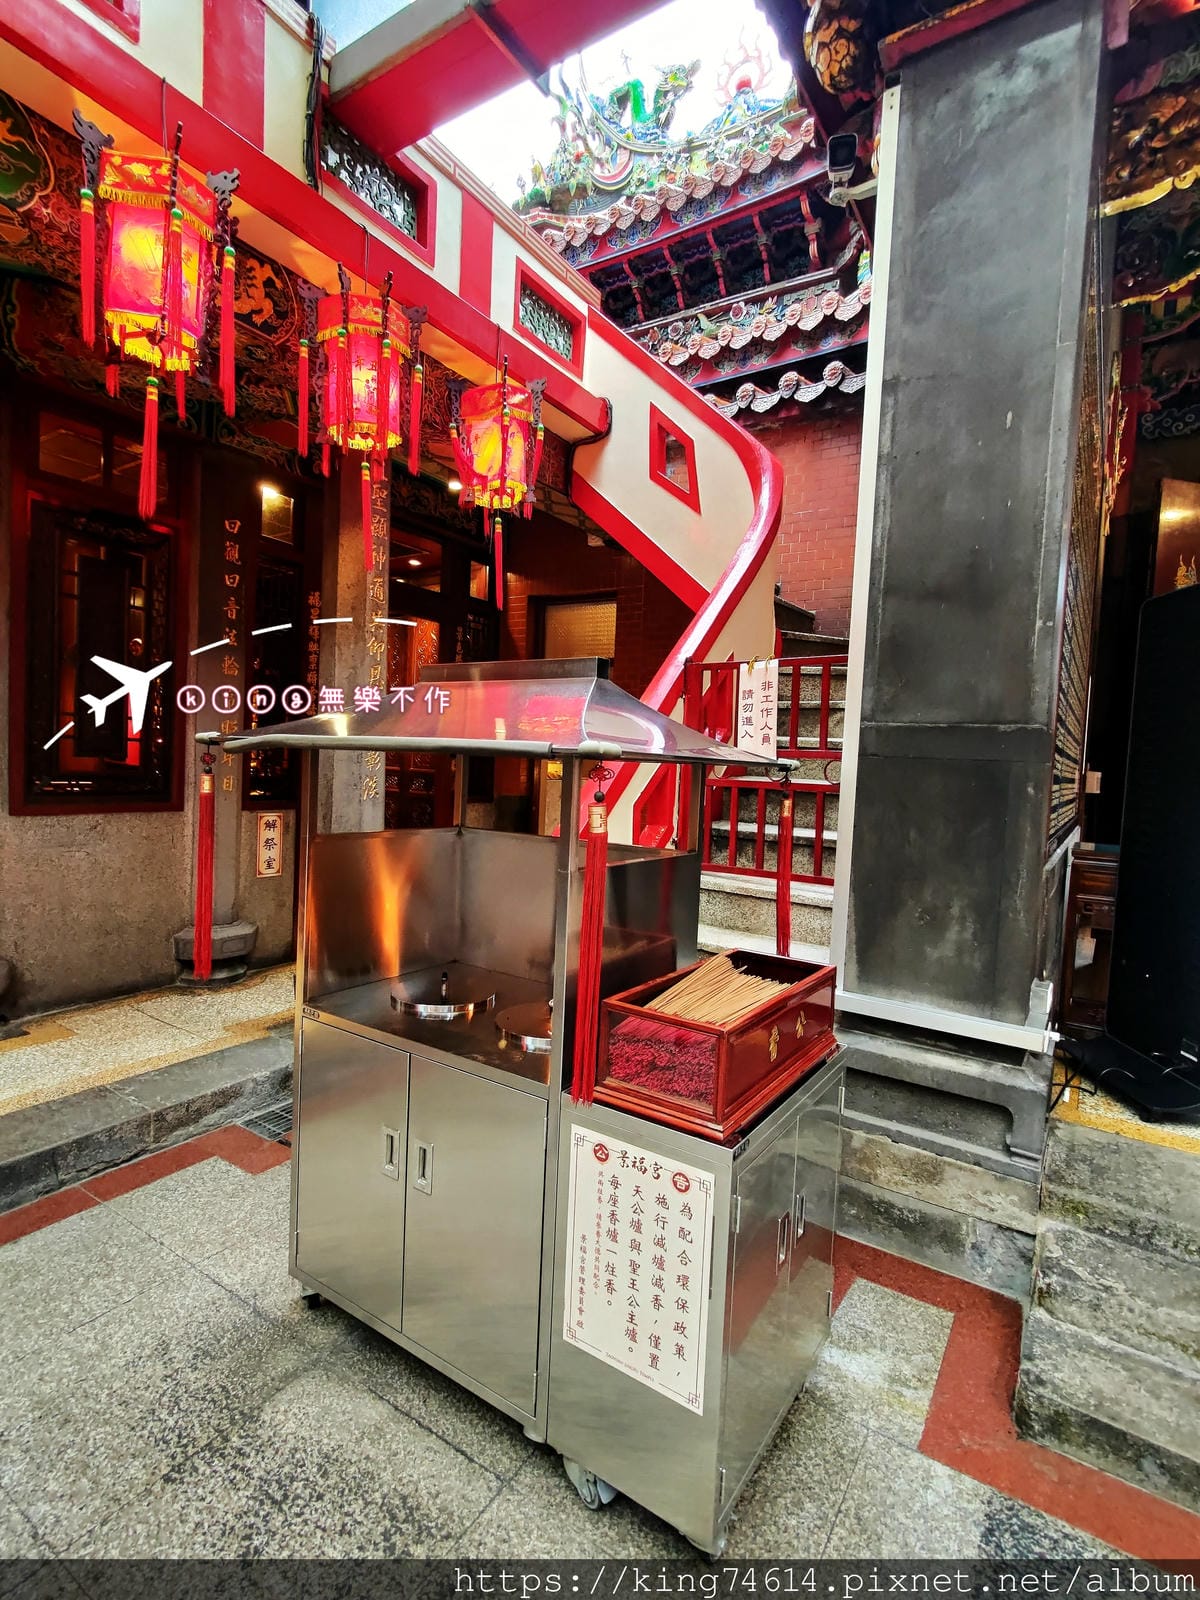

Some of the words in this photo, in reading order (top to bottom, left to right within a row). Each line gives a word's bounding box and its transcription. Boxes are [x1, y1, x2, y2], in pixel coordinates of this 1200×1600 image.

[741, 689, 754, 739] 請勿進入
[760, 680, 774, 746] 非工作人員
[262, 819, 278, 870] 解祭室
[617, 1149, 664, 1181] 景福宮
